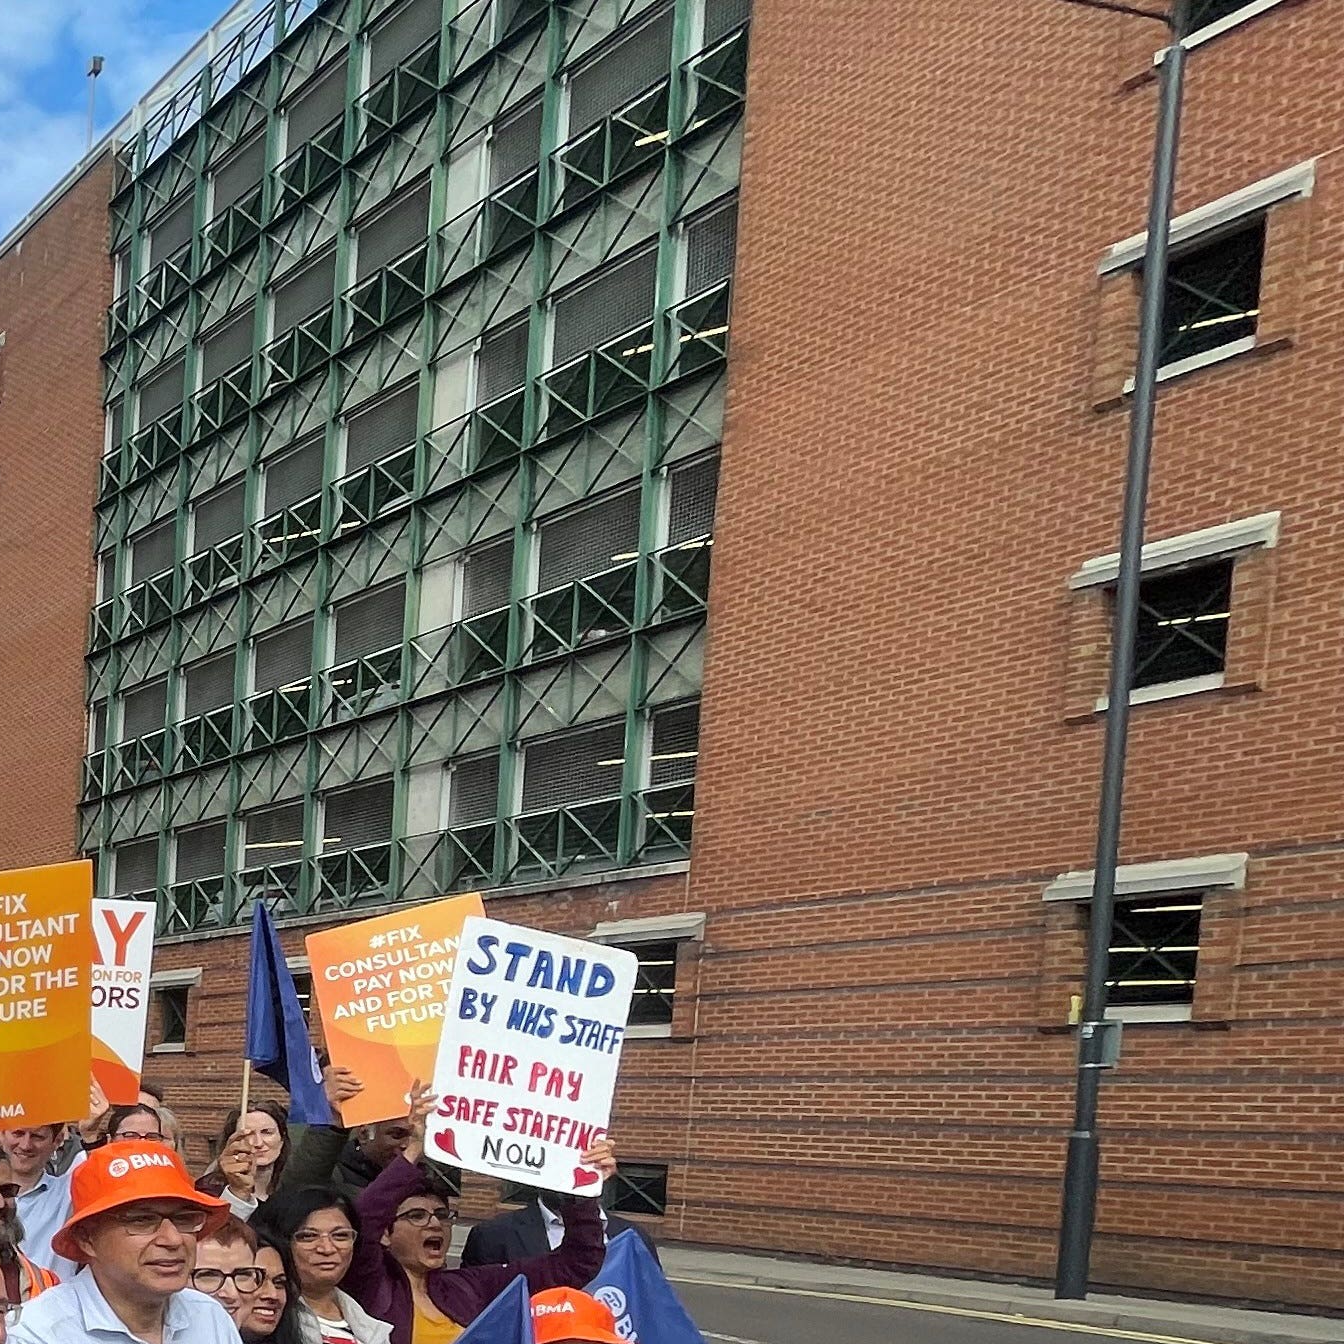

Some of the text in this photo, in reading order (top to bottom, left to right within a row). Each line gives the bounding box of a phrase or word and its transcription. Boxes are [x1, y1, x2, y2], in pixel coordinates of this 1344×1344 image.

[369, 924, 423, 949] #FIX
[324, 935, 461, 982] CONSULTAN
[466, 934, 615, 998] STAND
[33, 966, 79, 991] THE
[116, 970, 143, 983] FOR
[353, 957, 454, 996] PAY NOW
[333, 996, 383, 1021] AND
[386, 985, 434, 1011] FOR
[365, 1000, 447, 1033] FUTUR
[460, 986, 498, 1024] BY
[506, 998, 559, 1039] NHS
[558, 1014, 625, 1055] STAFF
[457, 1045, 584, 1102] FAIR PAY
[437, 1094, 609, 1152] SAFE STAFFING
[129, 1152, 176, 1171] BMA
[481, 1135, 546, 1169] NOW
[535, 1301, 574, 1317] BMA
